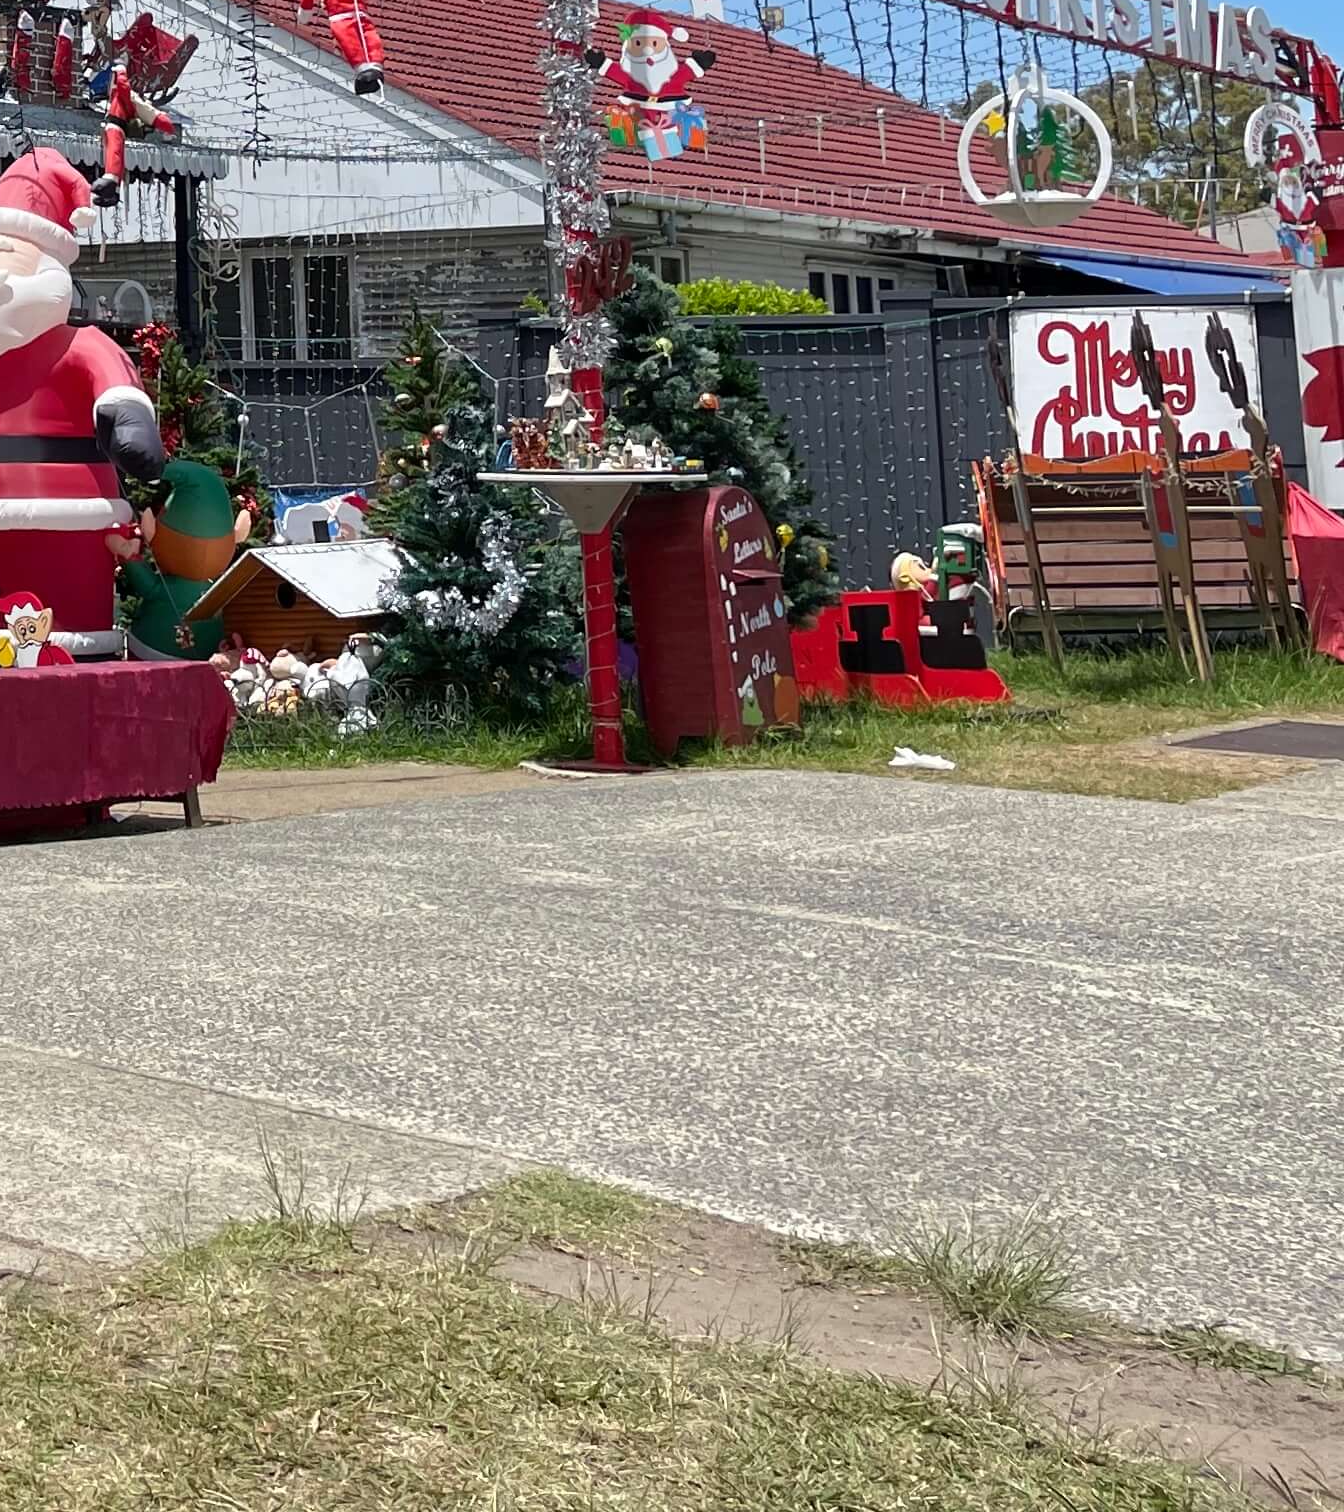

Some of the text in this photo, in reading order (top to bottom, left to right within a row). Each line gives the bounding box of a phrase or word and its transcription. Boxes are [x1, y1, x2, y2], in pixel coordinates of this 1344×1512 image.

[1037, 320, 1196, 418] Mery
[740, 603, 772, 638] North
[752, 649, 777, 681] Pole
